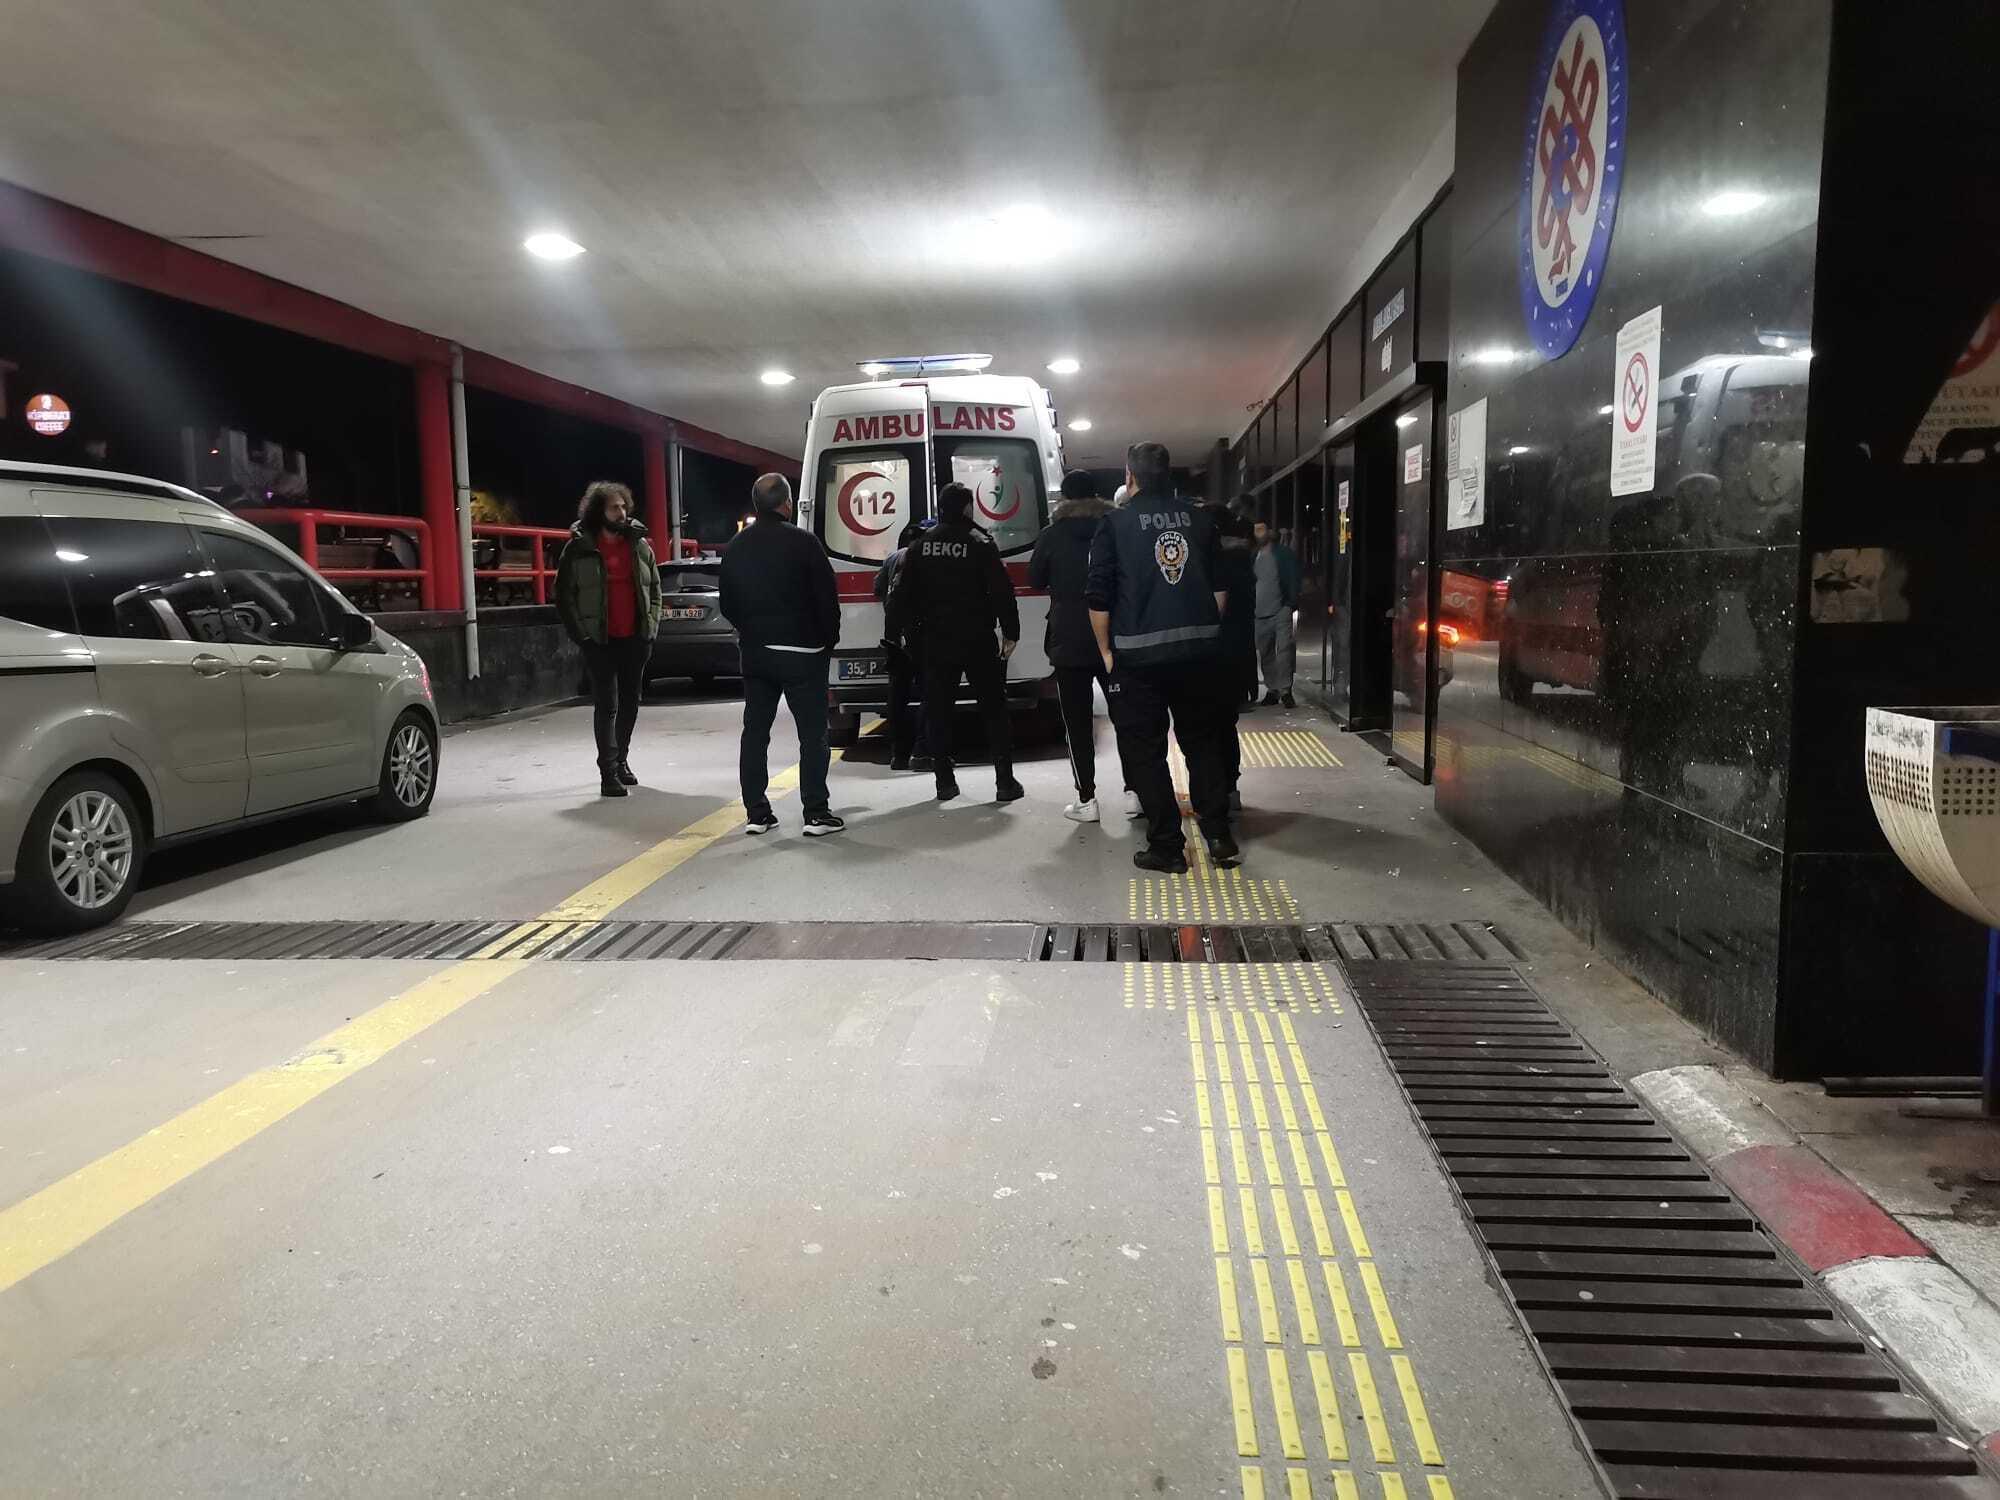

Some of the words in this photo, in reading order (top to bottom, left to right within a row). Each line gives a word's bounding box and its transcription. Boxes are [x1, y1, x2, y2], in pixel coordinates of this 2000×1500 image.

[833, 406, 1017, 442] AMBULANS
[853, 491, 896, 516] 112
[847, 661, 861, 675] 35
